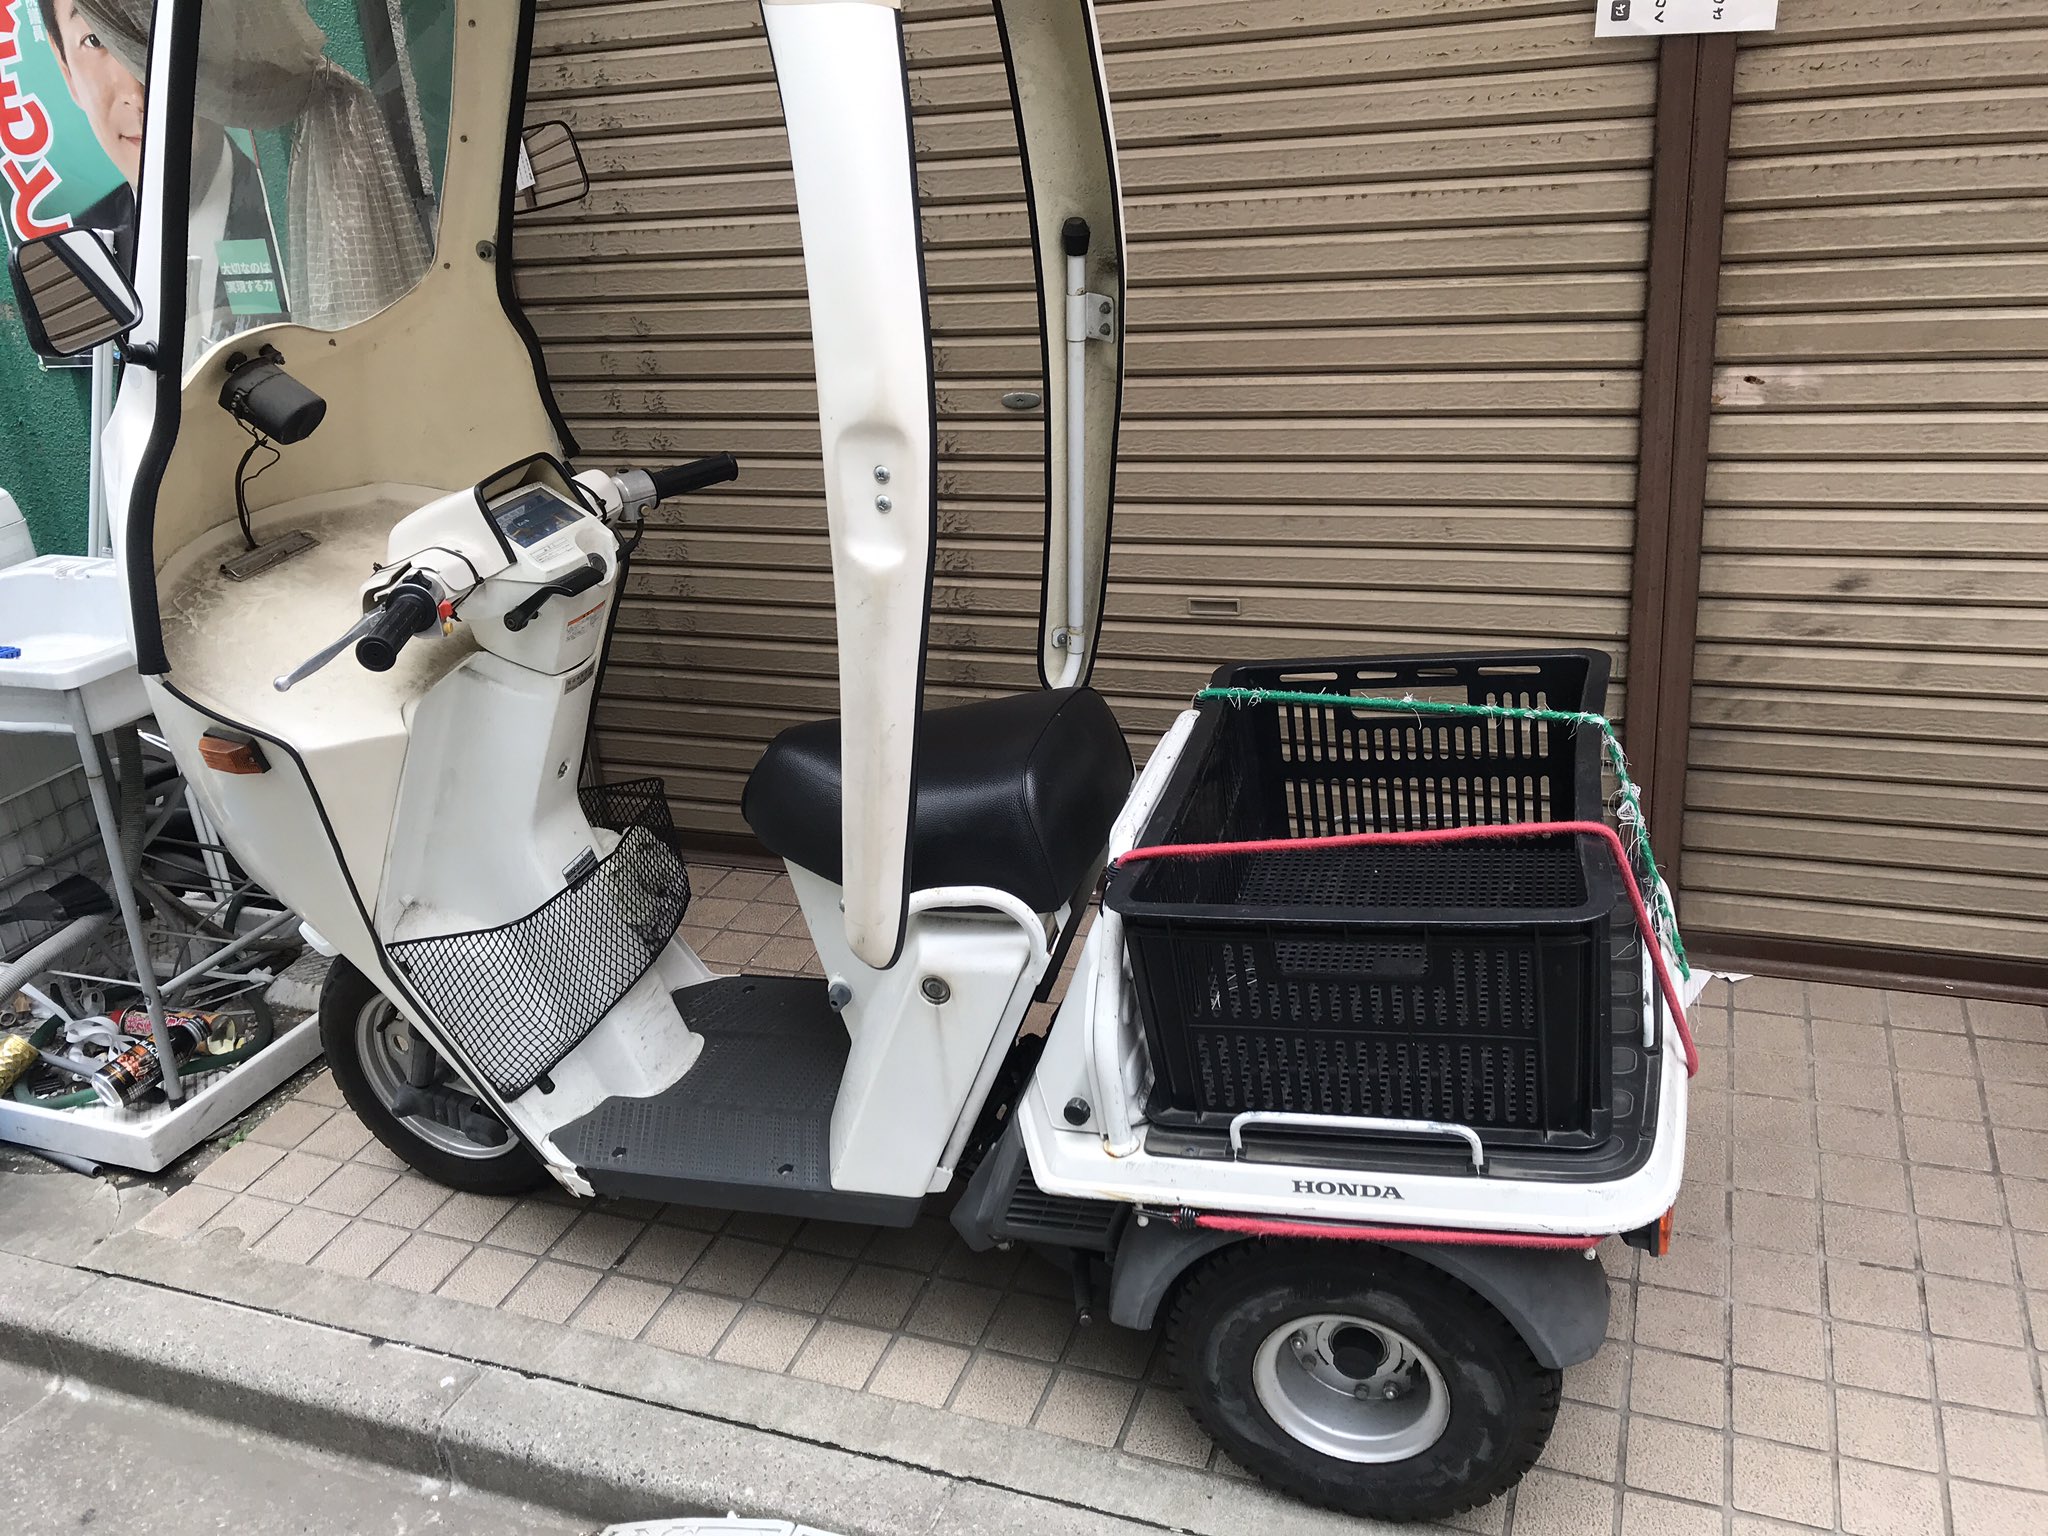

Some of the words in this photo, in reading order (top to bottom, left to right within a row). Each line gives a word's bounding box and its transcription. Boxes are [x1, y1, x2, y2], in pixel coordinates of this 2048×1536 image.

[221, 262, 272, 275] 大切なのは
[225, 280, 273, 293] 実現する力
[1291, 1179, 1405, 1200] HONDA
